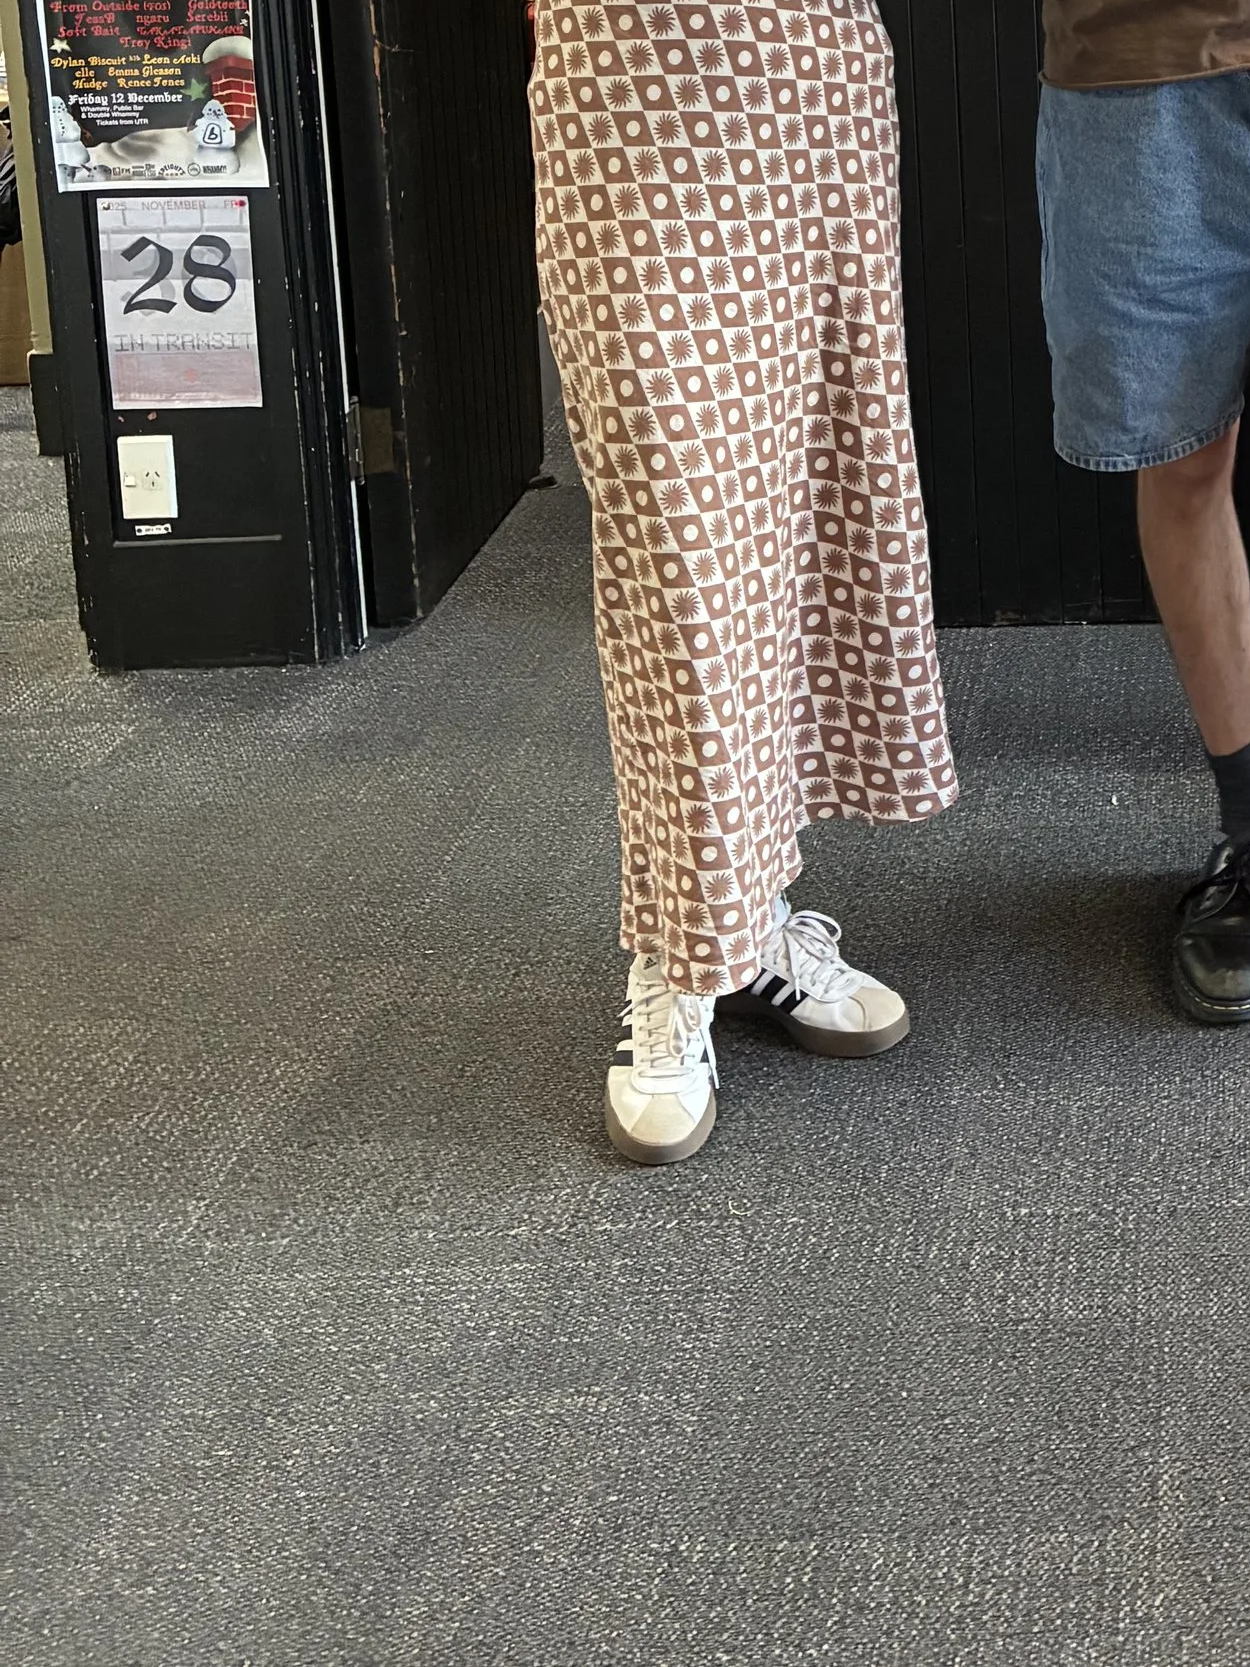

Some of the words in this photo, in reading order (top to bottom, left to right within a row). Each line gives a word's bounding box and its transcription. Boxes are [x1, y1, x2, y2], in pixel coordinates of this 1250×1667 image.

[50, 1, 87, 13] From
[92, 0, 140, 12] Outside
[58, 26, 87, 38] Soft
[119, 37, 150, 49] Troy
[154, 36, 192, 49] Kingi
[51, 57, 85, 69] Dylan
[87, 55, 126, 67] Biscuit
[142, 54, 170, 65] Leon
[173, 53, 201, 64] Aoki
[75, 68, 95, 78] elle
[108, 67, 139, 77] Emma
[142, 66, 181, 78] Gleason
[117, 77, 151, 88] Renee
[153, 77, 185, 88] Jones
[68, 92, 109, 106] Friday
[111, 93, 125, 104] 12
[127, 92, 183, 103] December
[113, 104, 132, 112] Public
[88, 111, 110, 119] Double
[142, 200, 206, 211] NOVEMBER
[120, 234, 237, 315] 28
[113, 334, 145, 352] IN
[151, 332, 253, 352] TRANSIT
